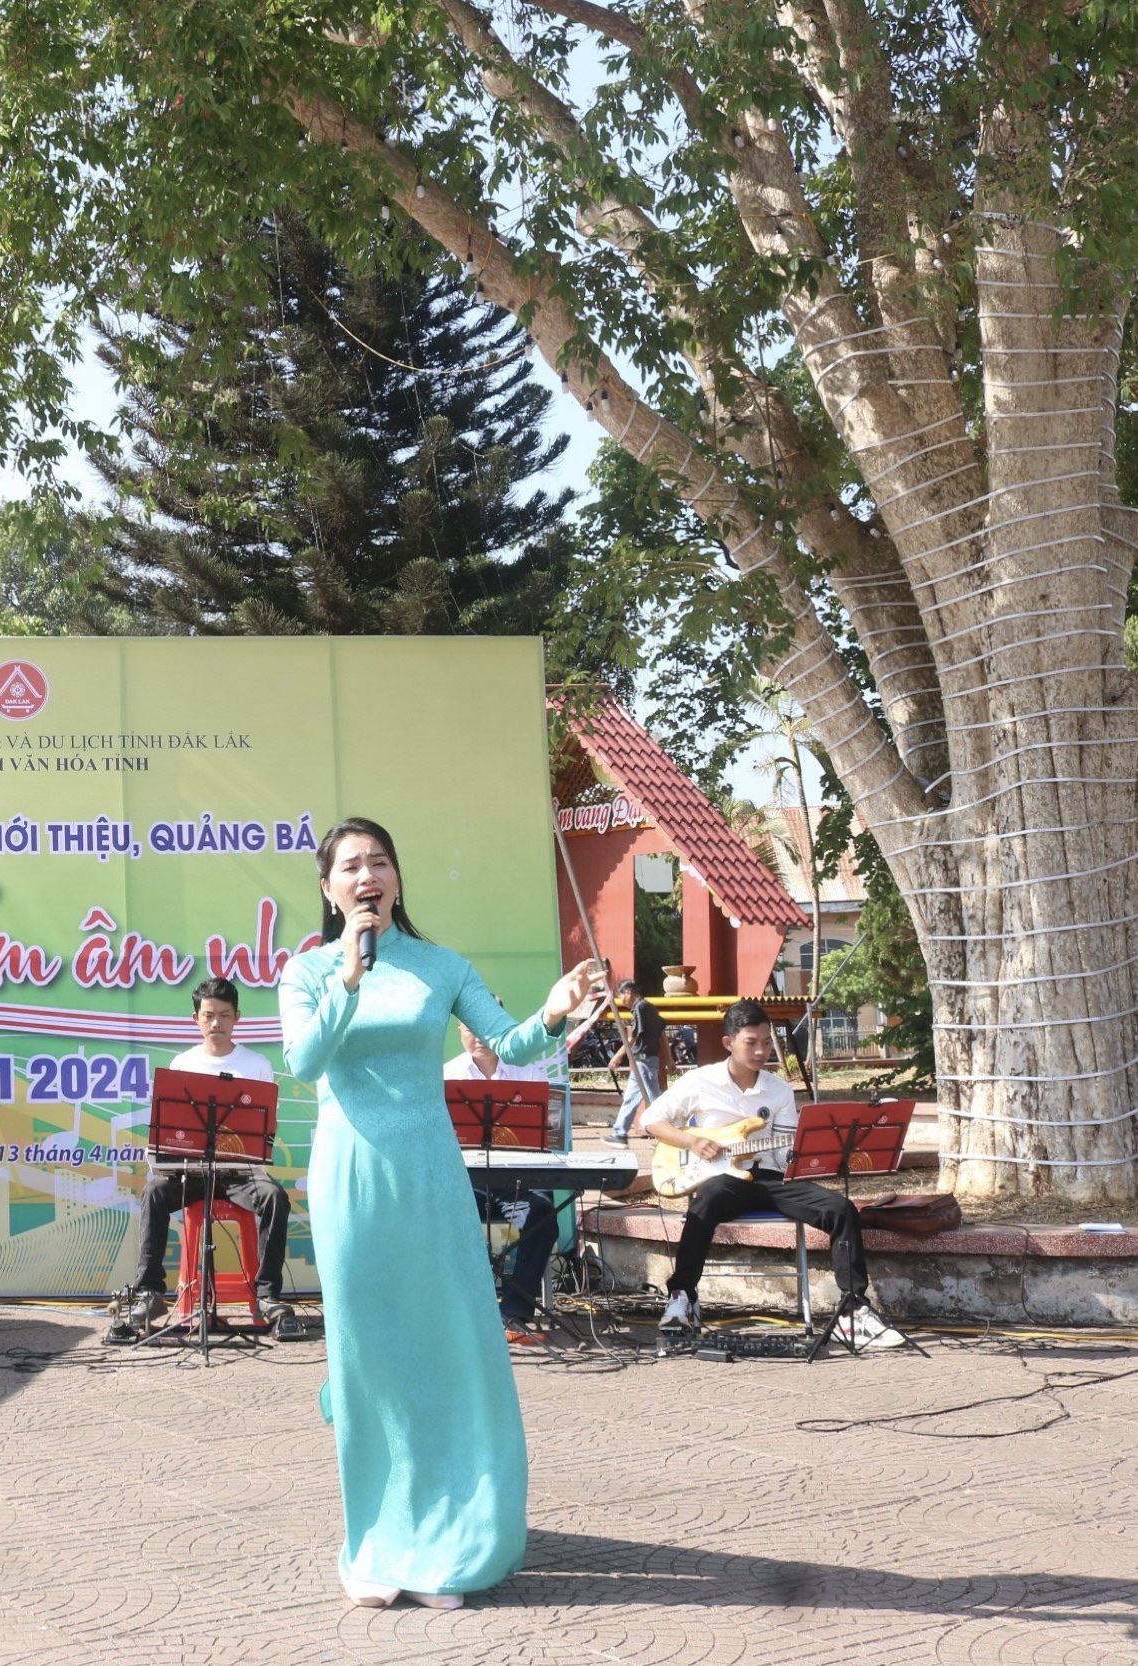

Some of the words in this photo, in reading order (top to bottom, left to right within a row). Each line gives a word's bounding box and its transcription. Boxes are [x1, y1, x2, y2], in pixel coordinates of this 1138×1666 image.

[6, 731, 33, 750] VÀ
[38, 735, 65, 750] DU
[70, 735, 113, 751] LỊCH
[118, 730, 163, 749] TỈNH
[168, 730, 208, 749] ĐẮK
[214, 730, 252, 749] LẮK
[9, 754, 50, 772] VĂN
[56, 754, 97, 772] HÓA
[102, 753, 149, 771] TỈNH
[575, 804, 611, 833] vang
[48, 817, 140, 860] THIỆU,
[150, 813, 266, 852] QUẢNG
[276, 814, 317, 851] BÁ
[74, 908, 194, 986] âm
[206, 898, 324, 986] nh
[29, 1056, 150, 1101] 2024
[24, 1144, 85, 1167] tháng
[89, 1145, 102, 1162] 4
